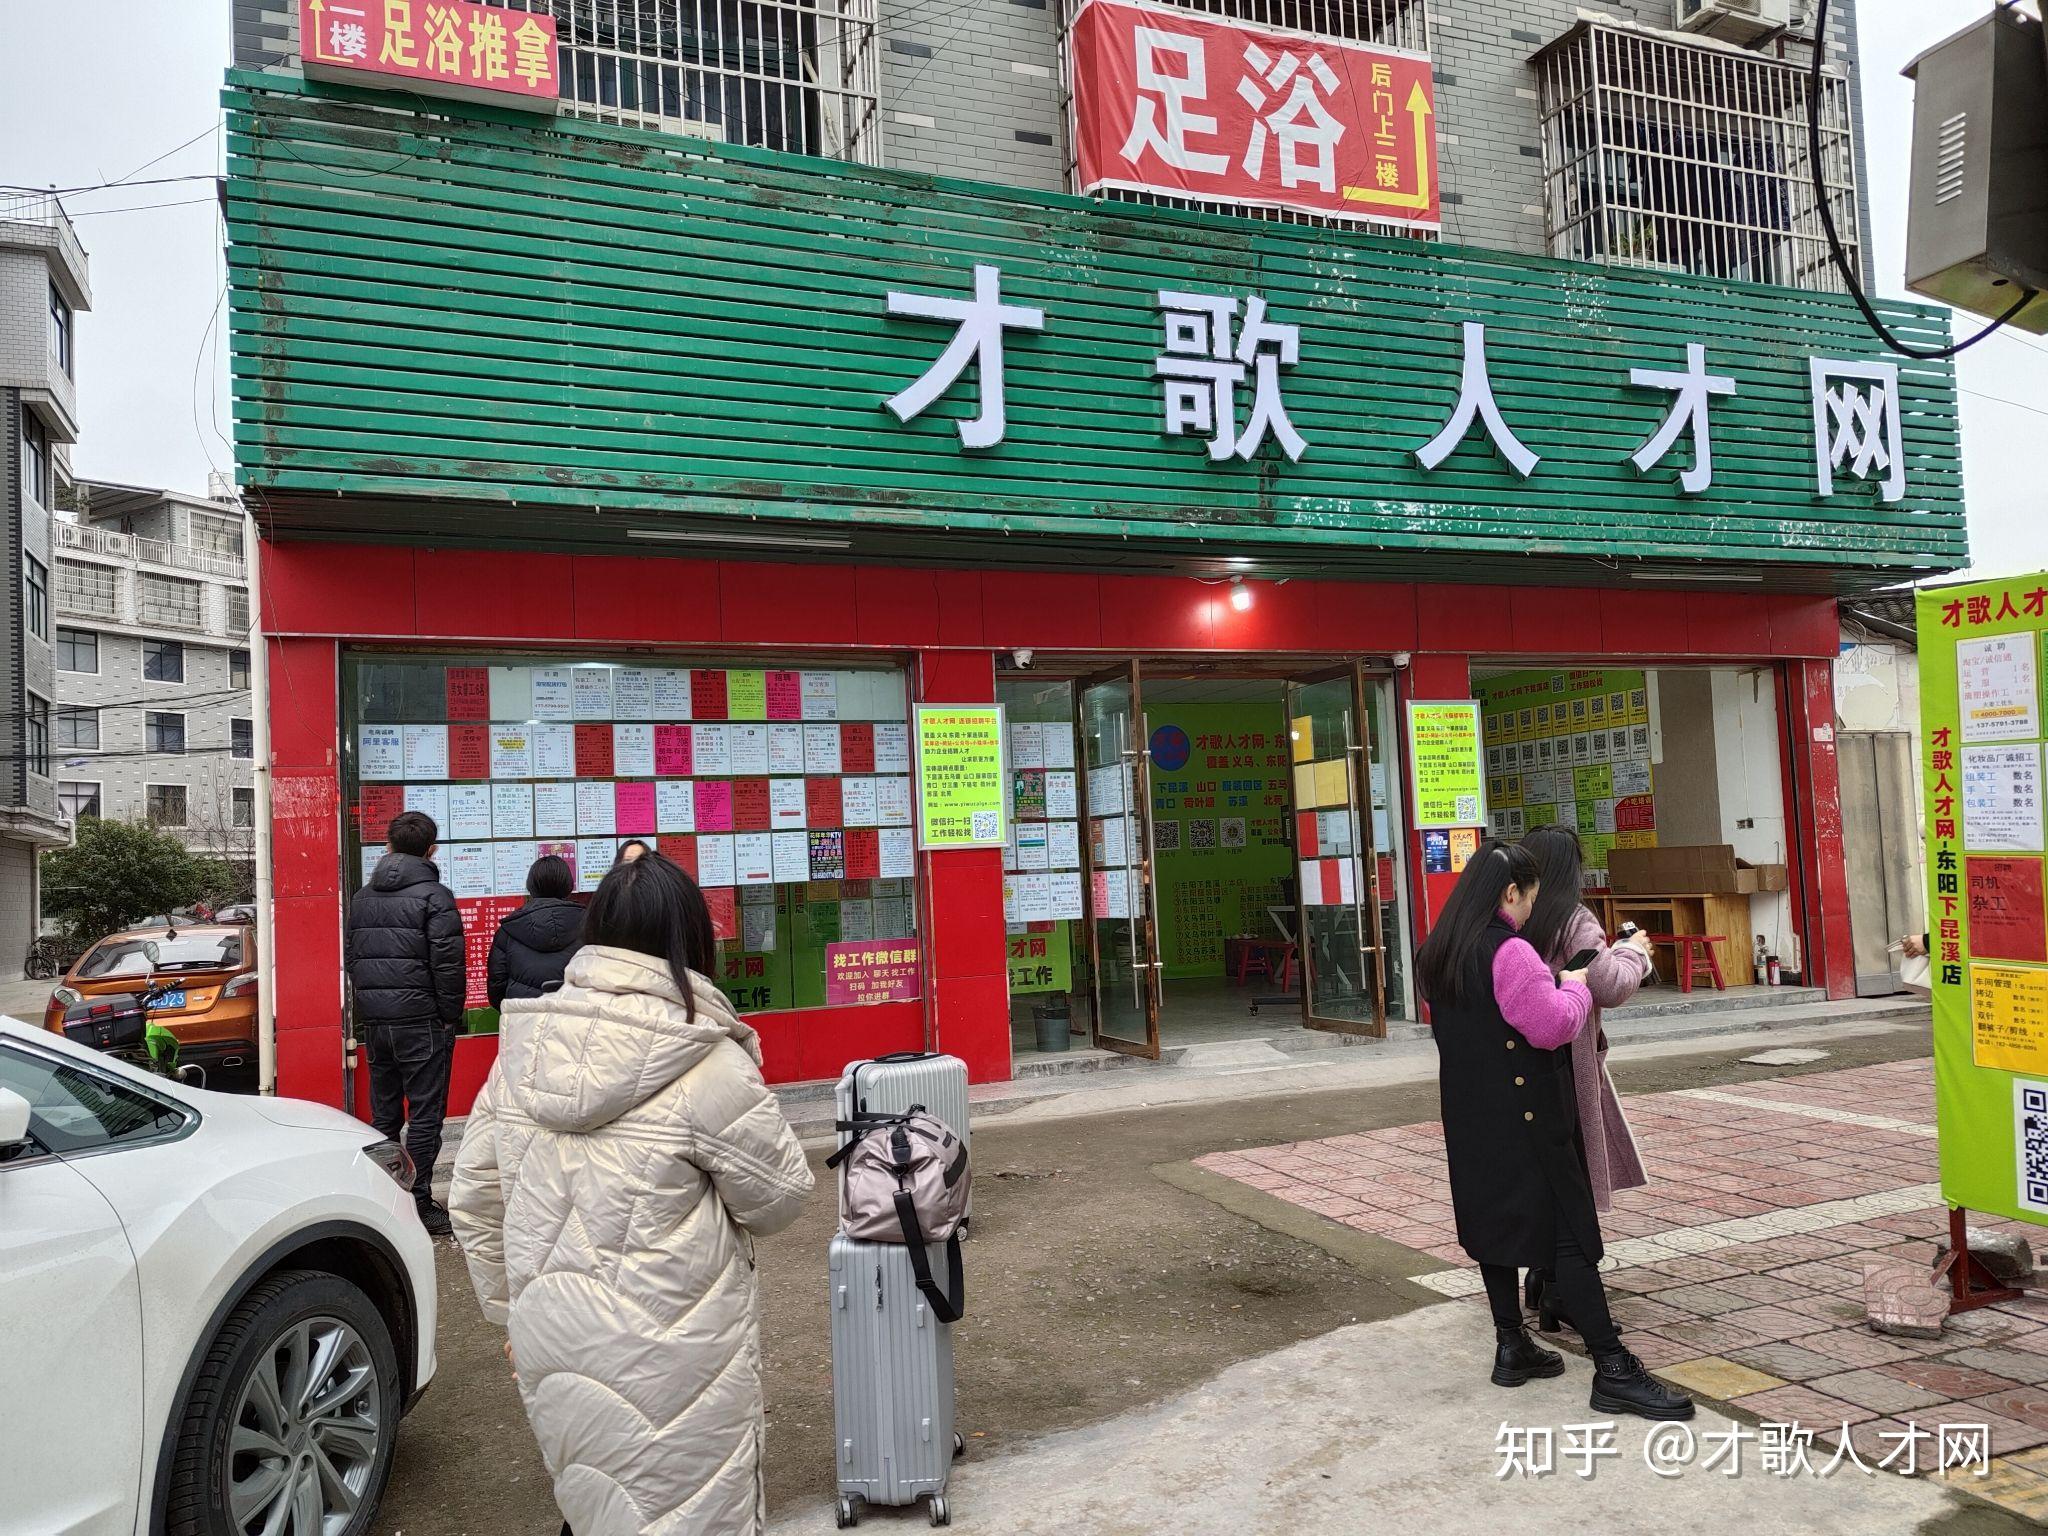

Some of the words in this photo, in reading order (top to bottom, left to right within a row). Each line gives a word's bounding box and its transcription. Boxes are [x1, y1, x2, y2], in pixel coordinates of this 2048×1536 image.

[378, 0, 552, 88] 足浴推拿
[1119, 25, 1347, 194] 足浴
[1371, 62, 1399, 189] 后门上二楼
[883, 263, 1907, 502] 才歌人才网
[2013, 771, 2033, 781] 数名
[2013, 784, 2033, 794] 数名
[1967, 799, 1996, 808] 包装工
[2013, 798, 2034, 807] 数名
[931, 827, 971, 838] 工作轻松找
[1971, 875, 2001, 890] 司机
[1972, 895, 2007, 911] 杂工
[833, 949, 917, 969] 找工作微信群
[836, 971, 870, 981] 欢迎加入
[891, 967, 916, 977] 找工作
[871, 979, 904, 990] 加我好友
